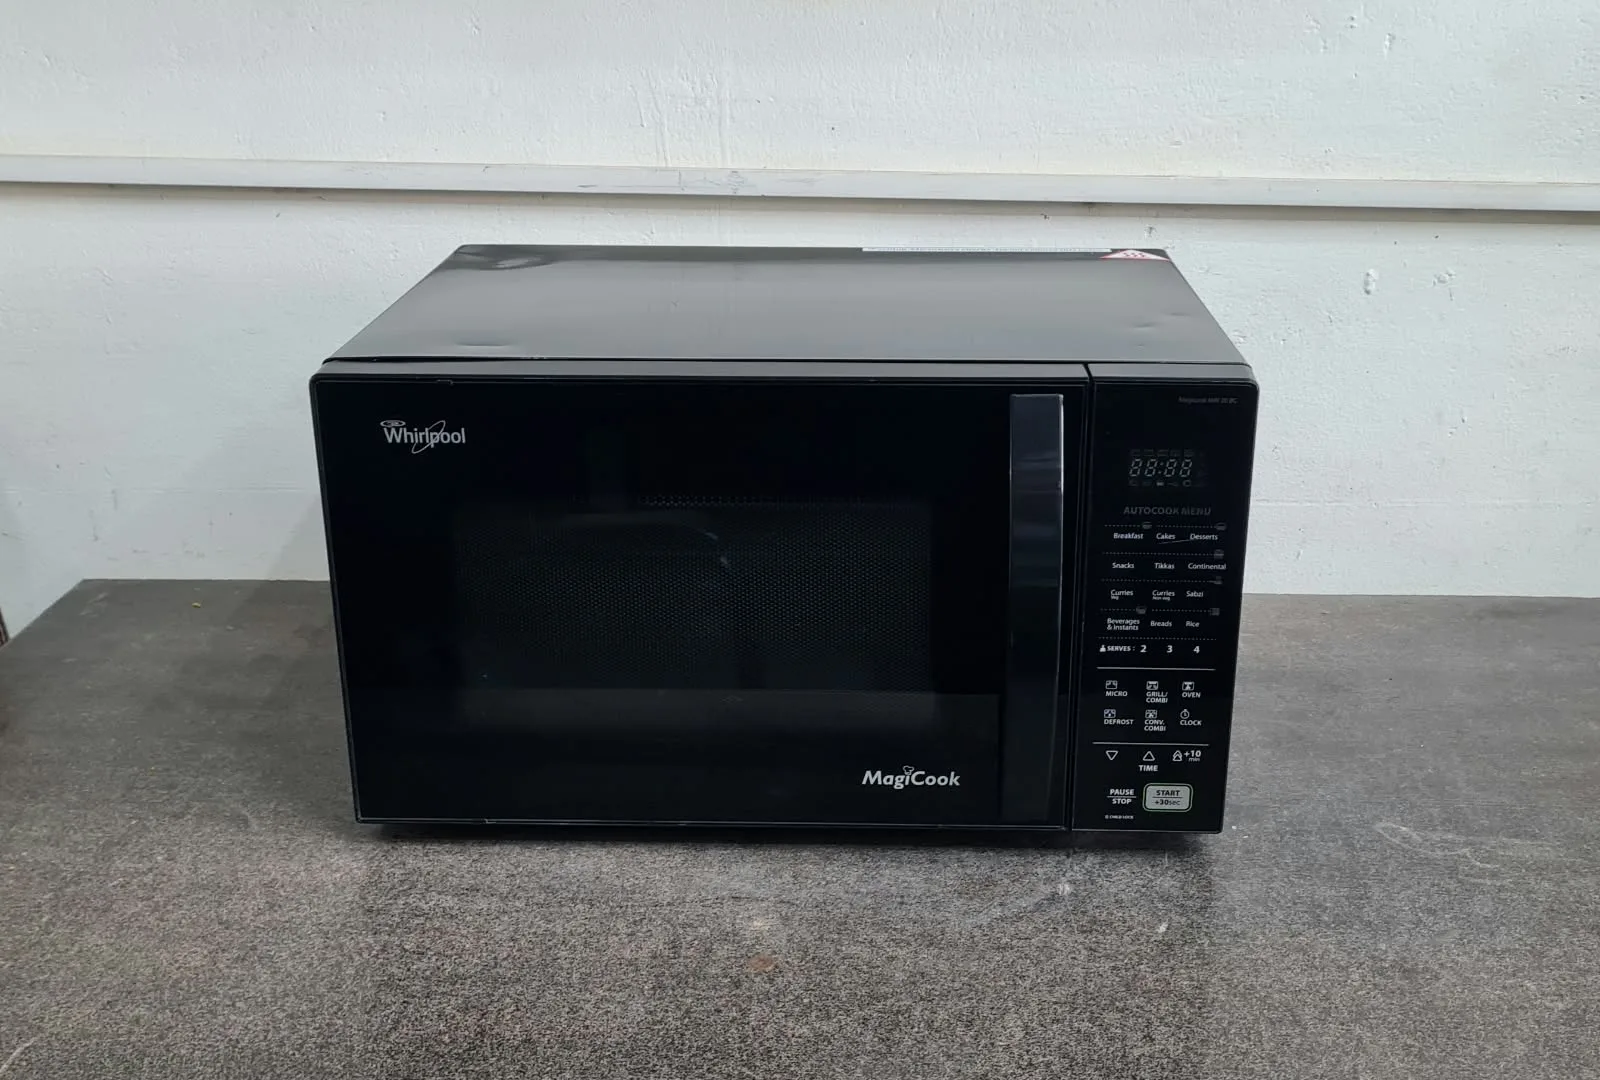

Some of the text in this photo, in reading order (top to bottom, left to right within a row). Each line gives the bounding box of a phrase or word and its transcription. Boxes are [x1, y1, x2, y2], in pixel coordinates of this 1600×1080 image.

[382, 422, 466, 451] Whirlpool
[1123, 506, 1211, 516] AUTOCOOK MENU
[1190, 533, 1218, 541] Desserts
[1154, 562, 1175, 570] Tikkas
[1186, 590, 1204, 598] Sabzi
[1107, 618, 1140, 626] Beverages
[1140, 644, 1147, 653] 2
[1166, 644, 1173, 654] 3
[1193, 645, 1201, 654] 4
[1184, 750, 1201, 758] +10
[862, 766, 960, 789] MagiCook
